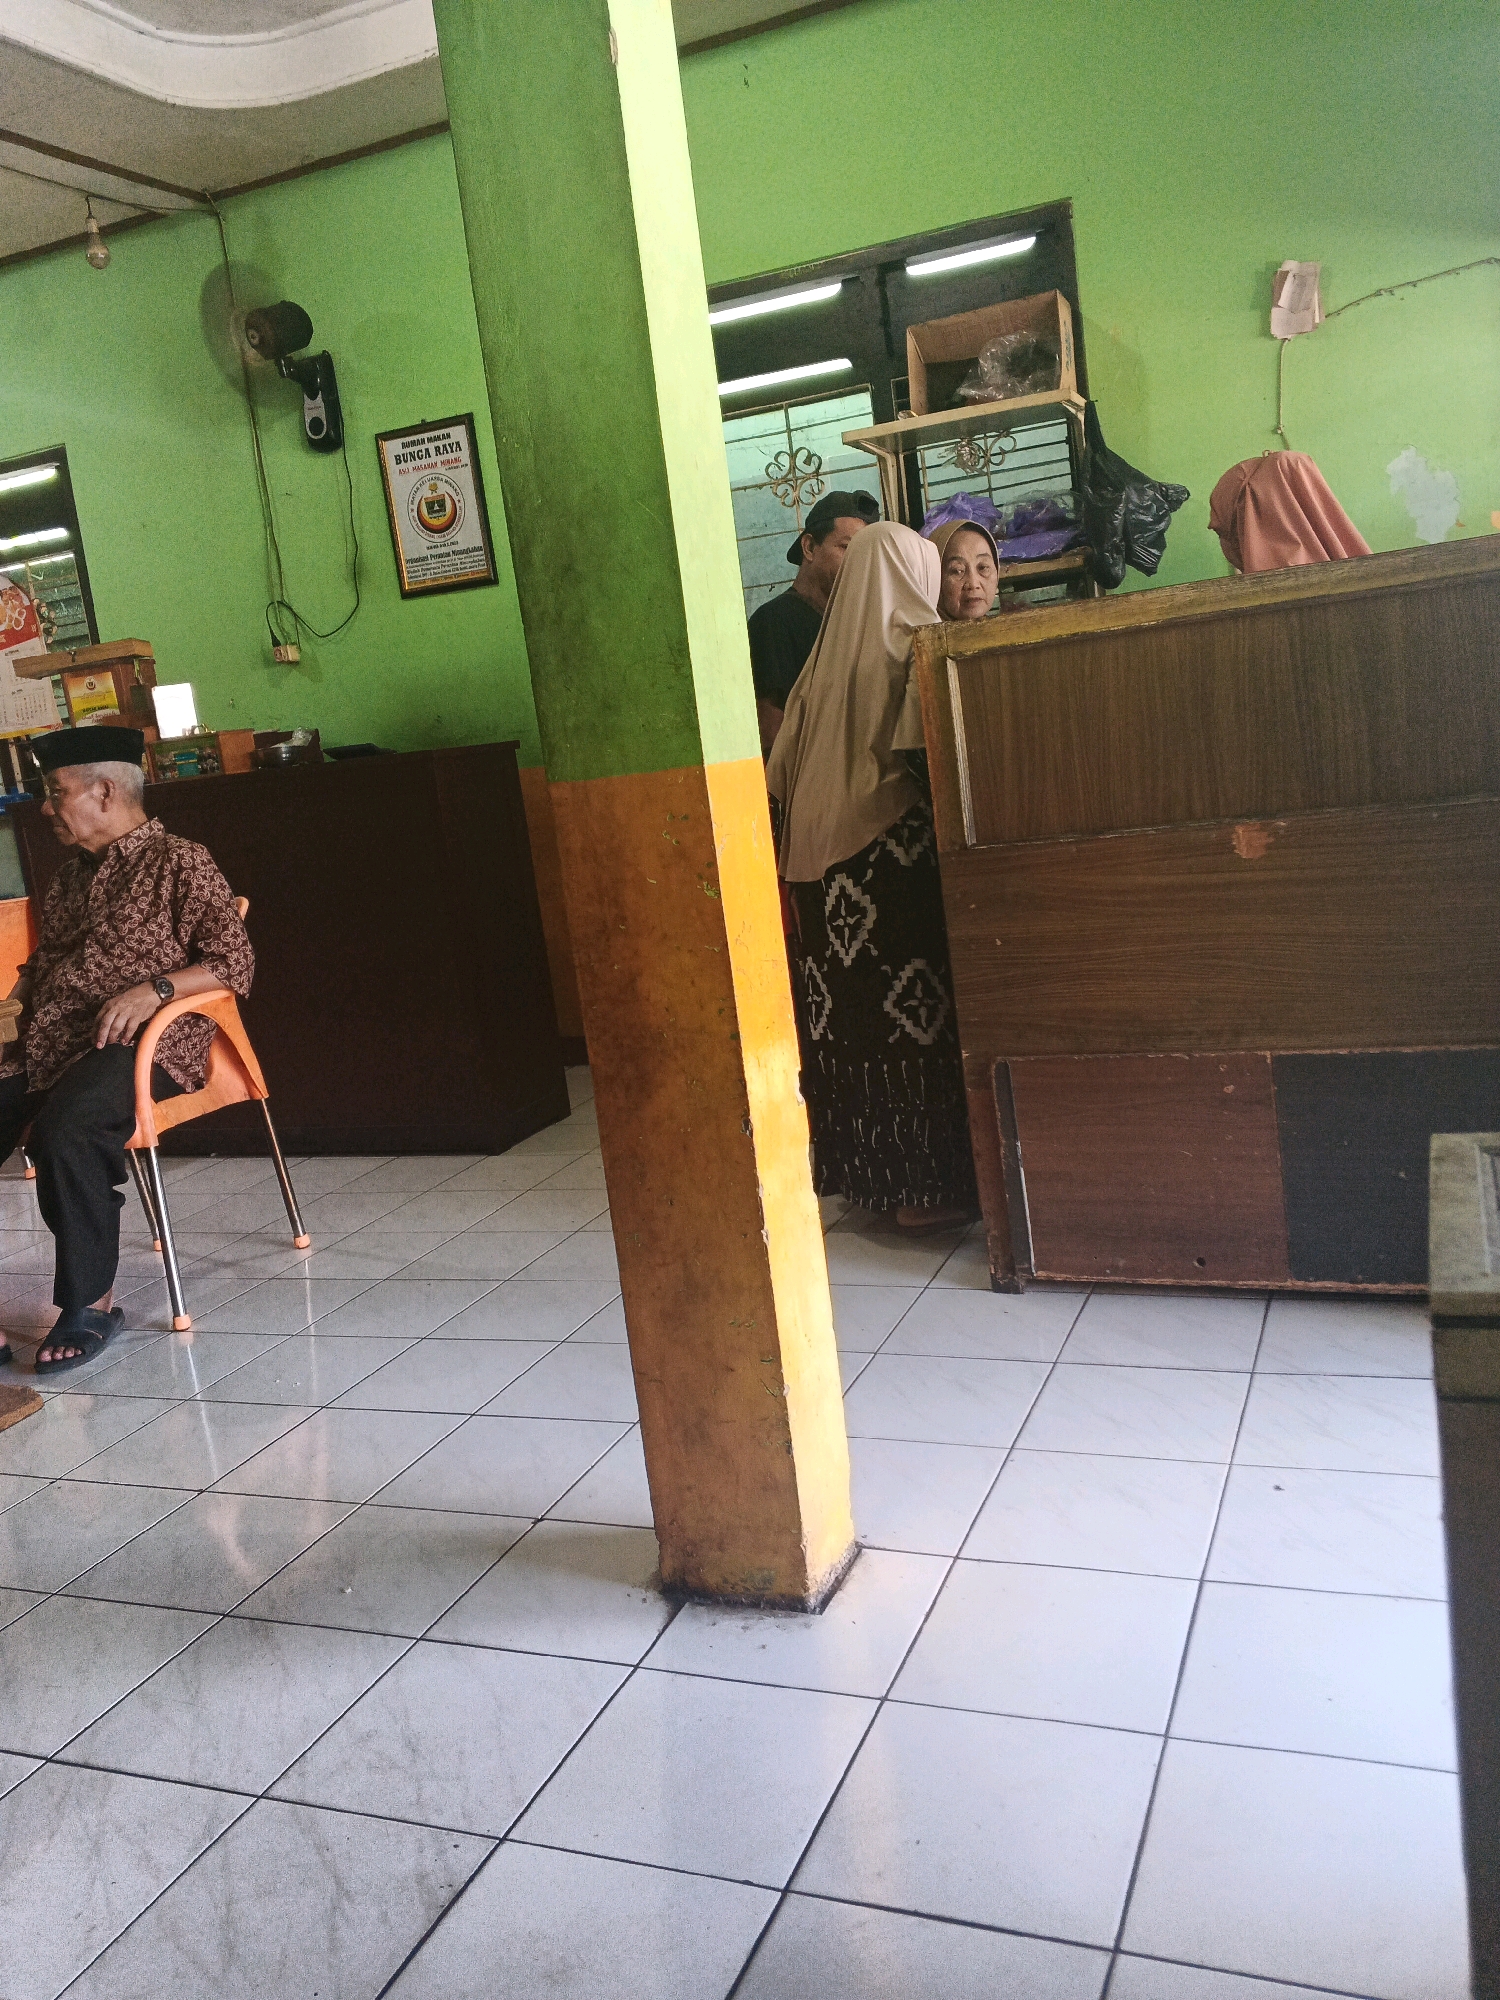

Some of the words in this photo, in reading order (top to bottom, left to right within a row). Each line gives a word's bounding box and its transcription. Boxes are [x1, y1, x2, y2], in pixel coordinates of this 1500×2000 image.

[401, 437, 426, 450] RUMAH
[426, 432, 451, 444] MAKAN
[394, 447, 431, 466] BUNGA
[434, 441, 462, 457] RAYA
[398, 467, 410, 476] ASLI
[412, 461, 438, 473] MASAKAN
[440, 456, 462, 467] MINANG
